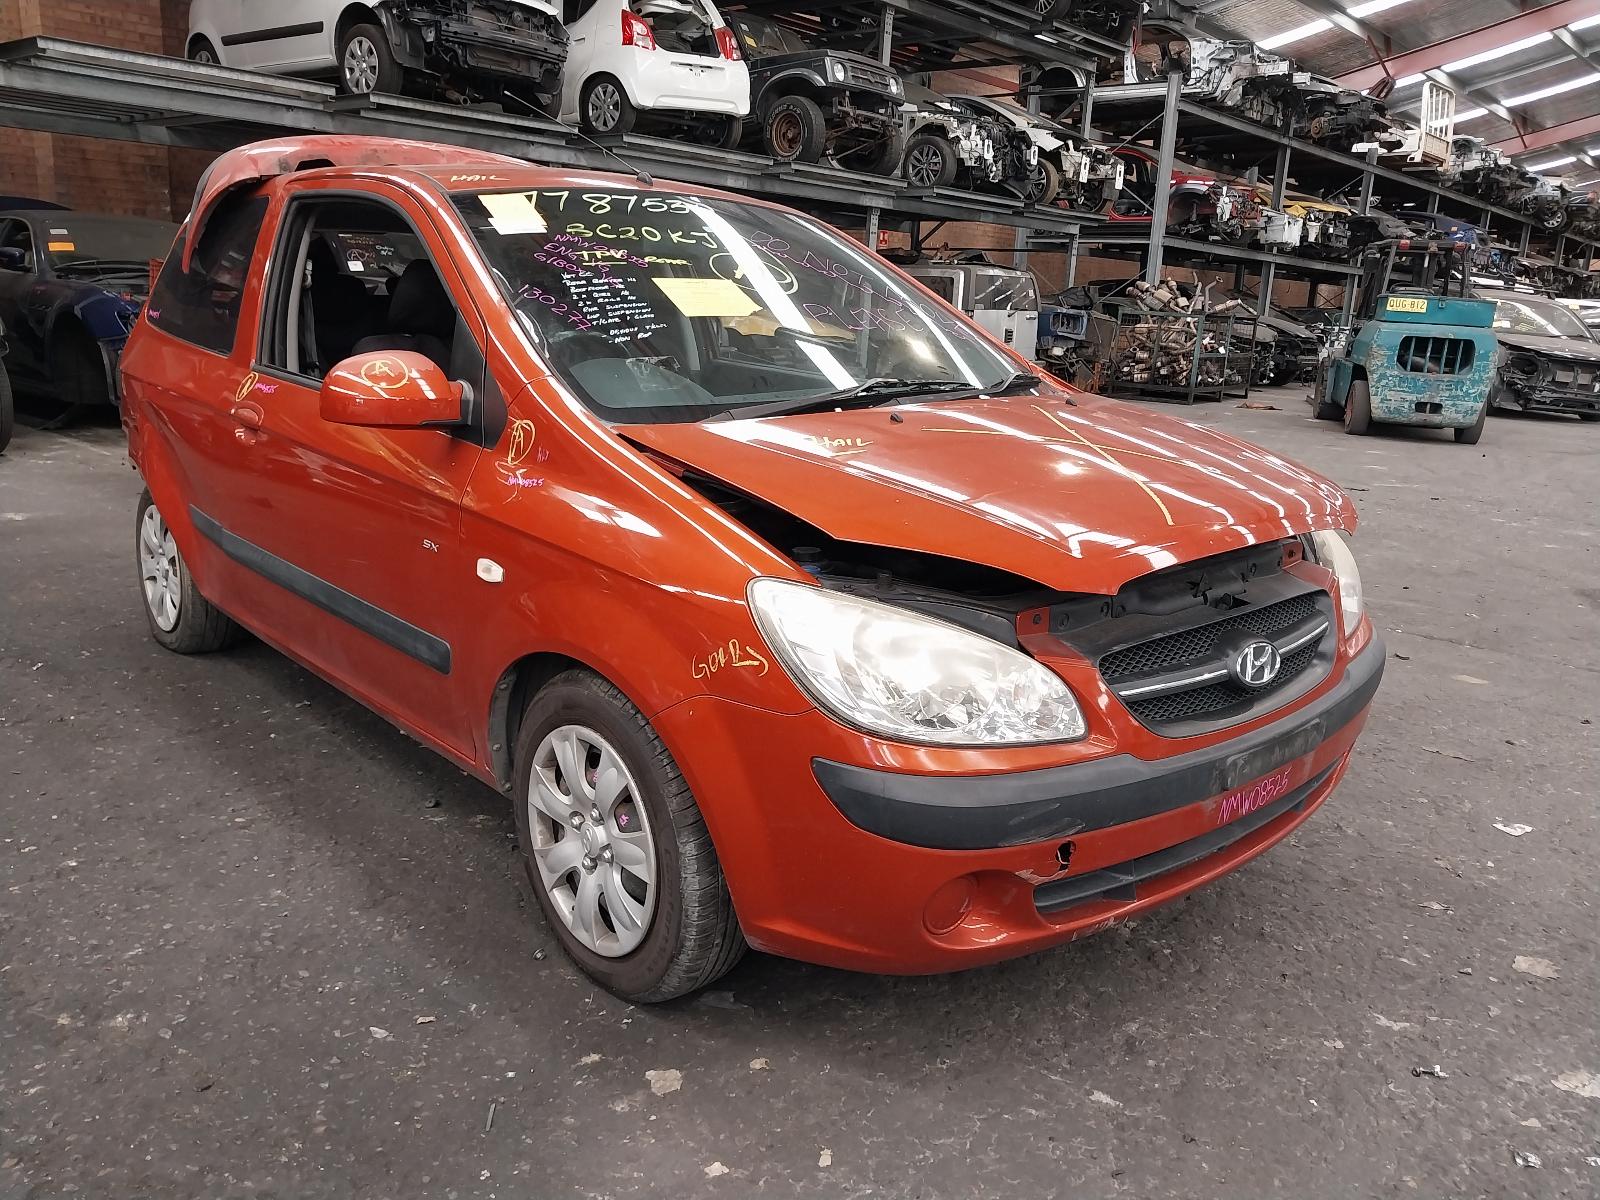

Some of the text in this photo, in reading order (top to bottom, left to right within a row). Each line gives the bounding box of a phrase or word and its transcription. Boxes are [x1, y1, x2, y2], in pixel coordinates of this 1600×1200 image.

[751, 230, 790, 251] DO
[803, 251, 873, 285] NOT
[422, 539, 440, 553] SX
[1217, 765, 1293, 825] NMW08525
